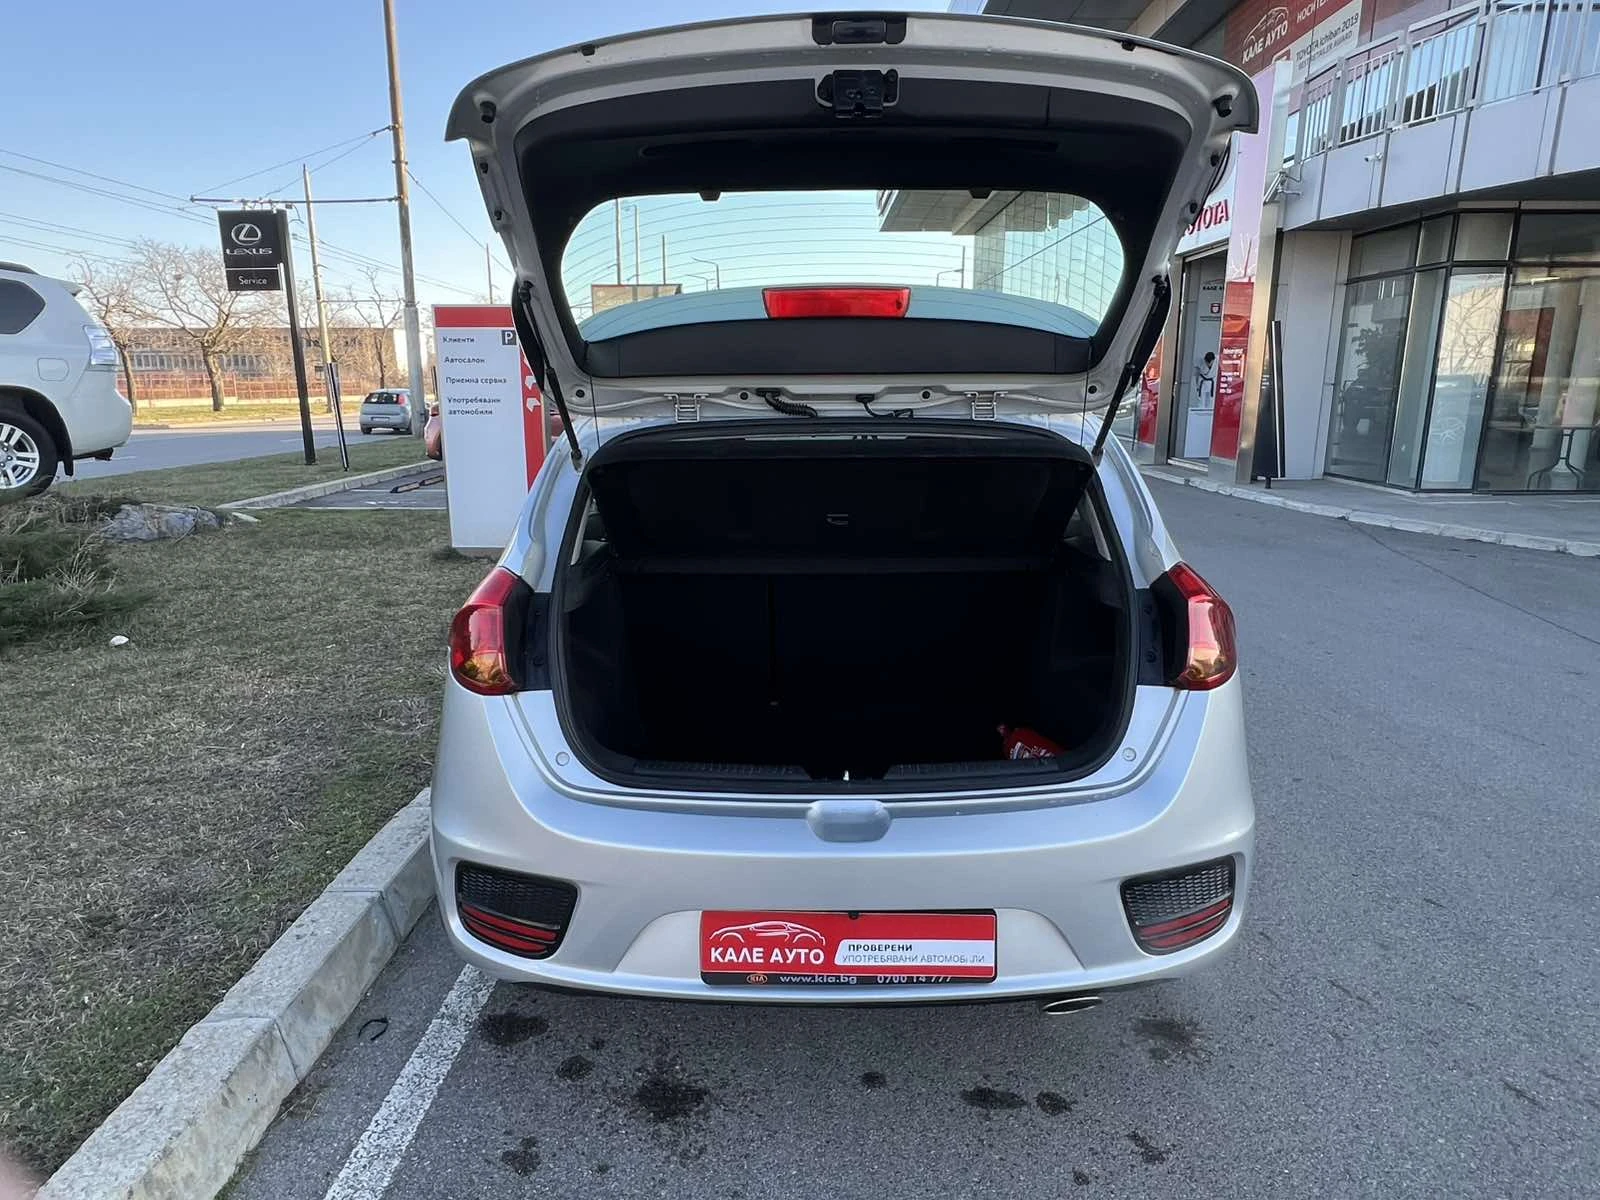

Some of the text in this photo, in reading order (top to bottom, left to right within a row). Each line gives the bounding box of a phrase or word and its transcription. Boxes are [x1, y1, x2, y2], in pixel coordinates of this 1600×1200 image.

[1342, 12, 1359, 32] 2019
[1242, 20, 1288, 64] КАЛЕ АУТО
[238, 276, 267, 285] Service
[444, 356, 485, 364] Автосалон
[445, 376, 479, 385] Приемна
[848, 944, 913, 952] ПРОВЕРЕНИ
[710, 947, 825, 964] КАЛЕ АУТО
[842, 954, 918, 963] УПОТРЕБЯВАНИ
[780, 974, 857, 984] www.kia.bg
